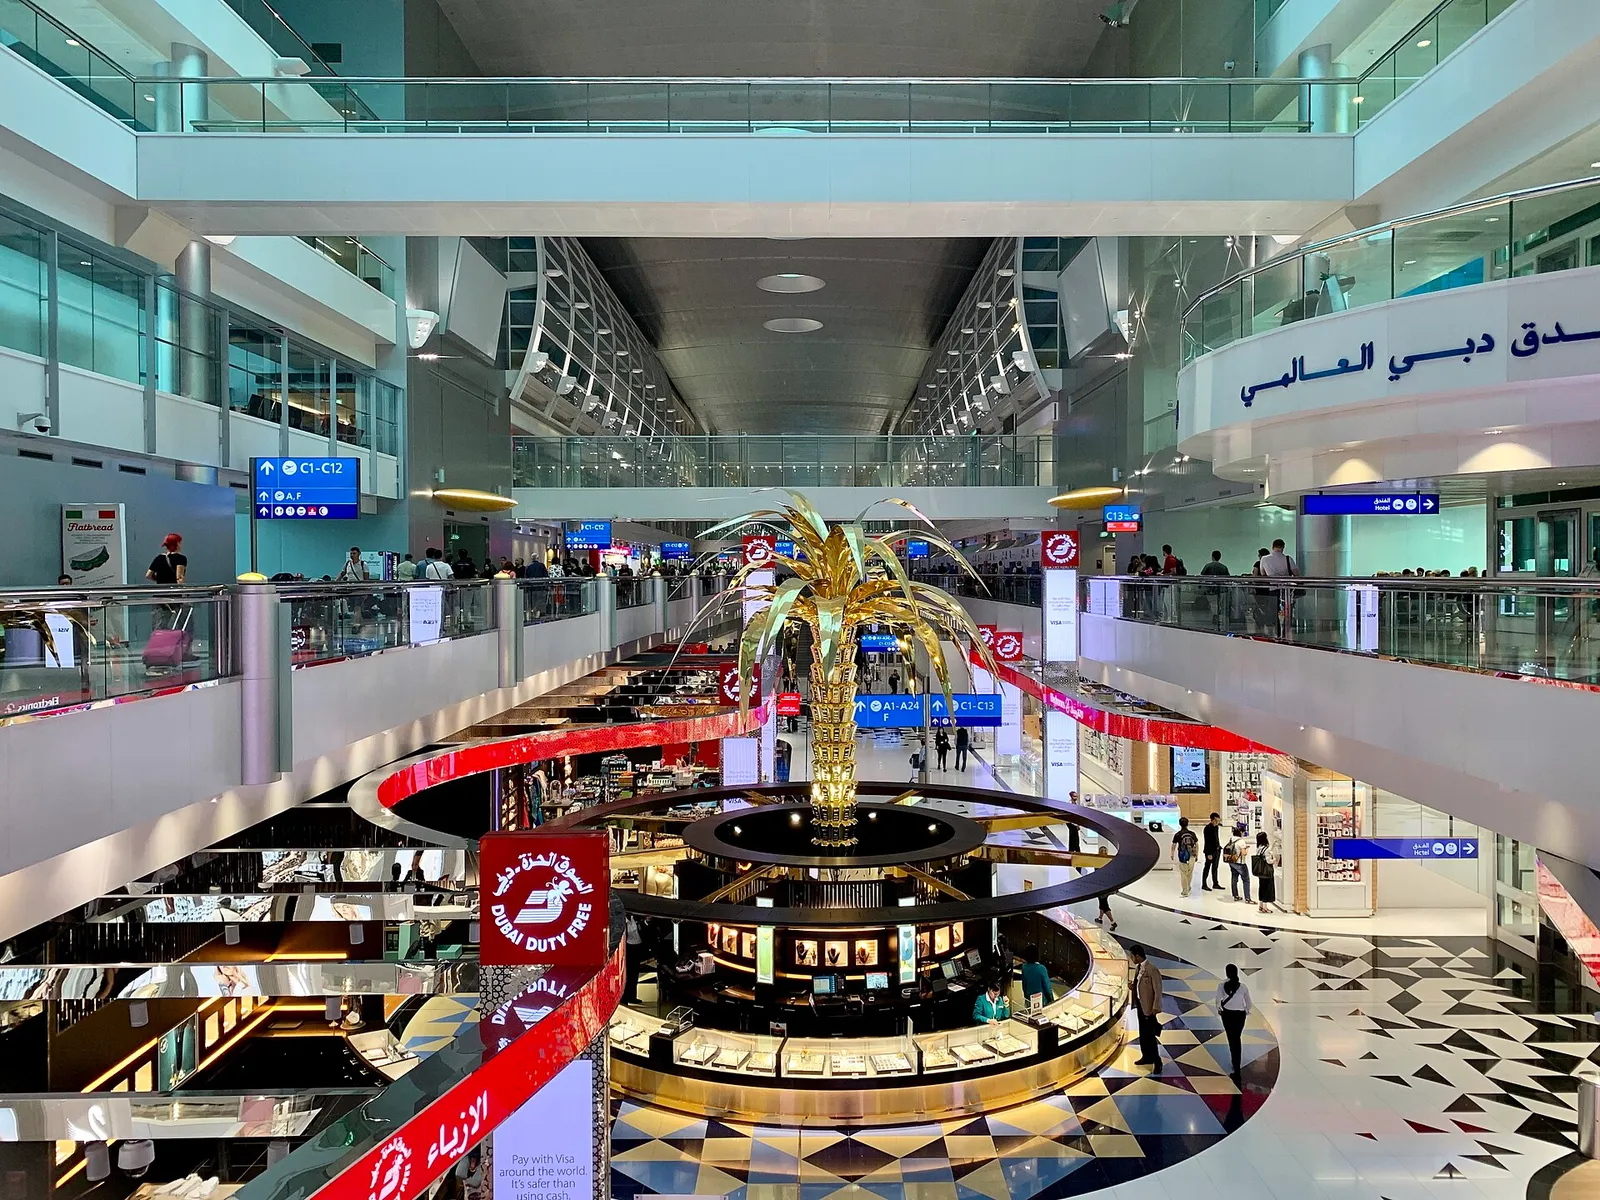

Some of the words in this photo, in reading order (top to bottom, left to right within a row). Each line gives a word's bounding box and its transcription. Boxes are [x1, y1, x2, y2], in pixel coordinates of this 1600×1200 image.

[1388, 331, 1495, 382] دبي
[1240, 341, 1374, 408] العالمي
[300, 462, 343, 474] C1-C12
[1106, 512, 1123, 521] C13
[67, 522, 114, 532] Flatbread
[883, 701, 920, 710] A1-A24
[960, 701, 995, 710] C1-C13
[883, 713, 889, 722] F
[491, 903, 524, 946] DUBAI
[525, 932, 568, 953] DUTY
[566, 902, 593, 939] FREE
[512, 1154, 530, 1166] Pay
[531, 1154, 554, 1164] with
[555, 1154, 575, 1164] Visa
[499, 1166, 535, 1177] around
[538, 1166, 555, 1176] the
[557, 1166, 588, 1176] world.
[511, 1179, 525, 1189] It's
[527, 1178, 550, 1189] safer
[553, 1179, 576, 1188] than
[516, 1191, 544, 1200] using
[545, 1190, 571, 1200] cash.
